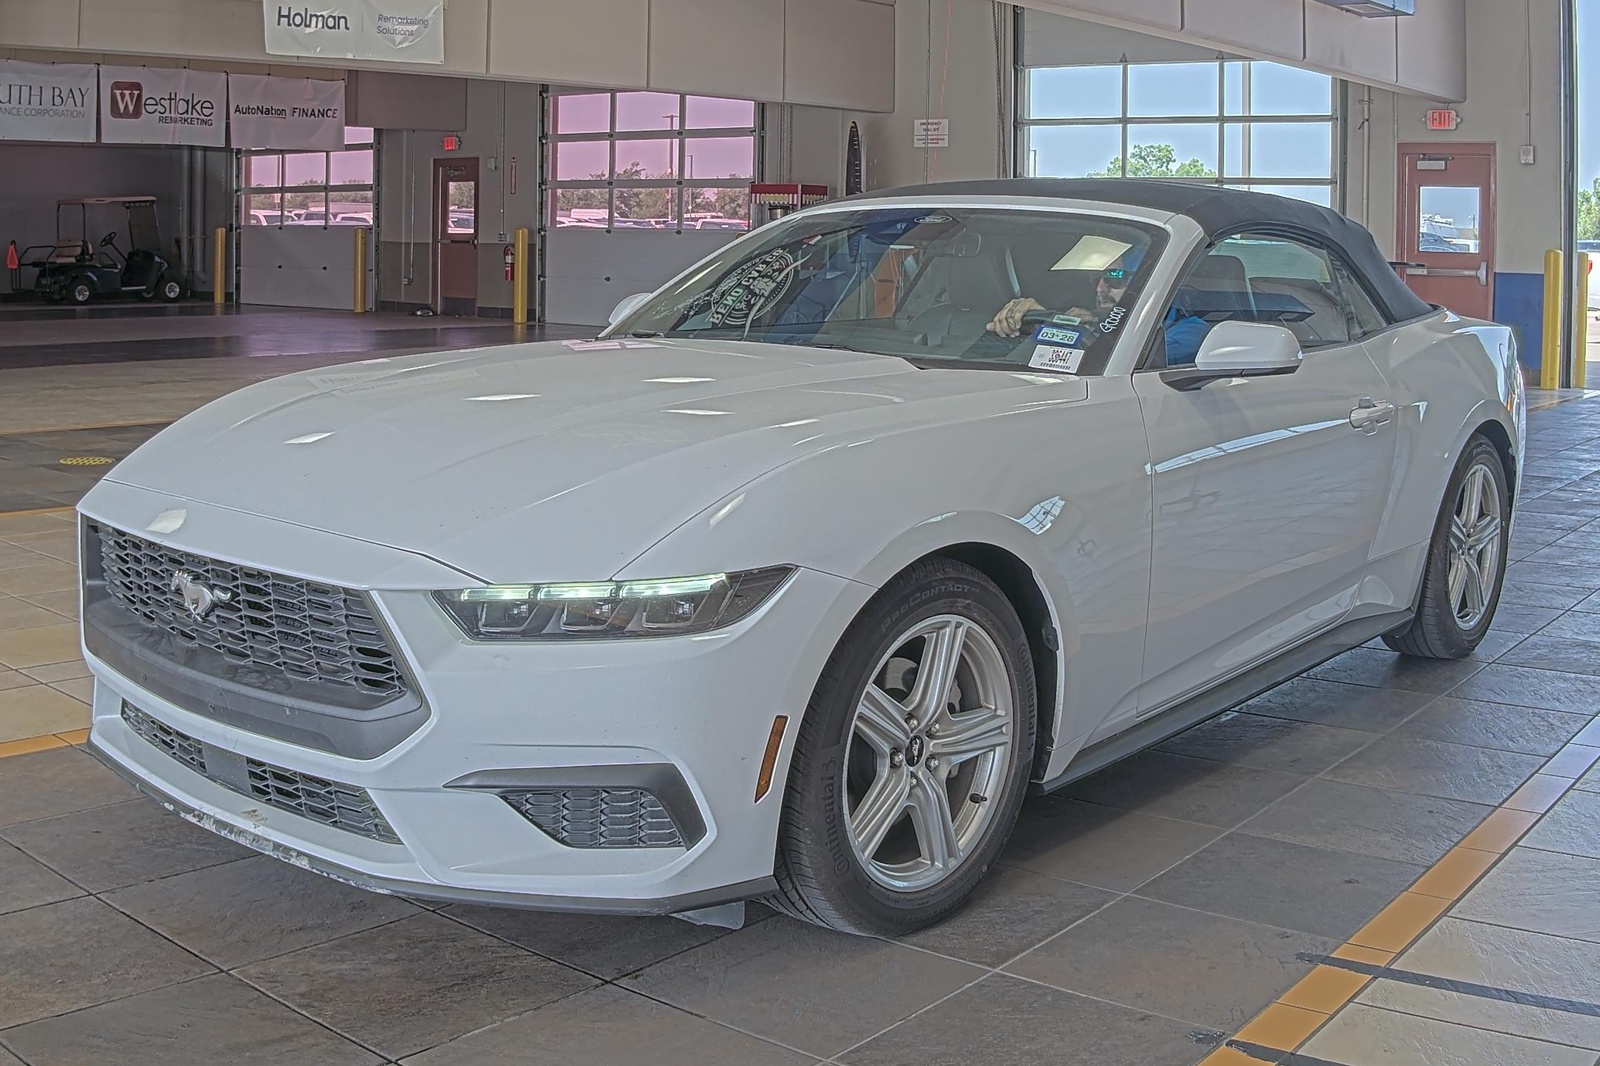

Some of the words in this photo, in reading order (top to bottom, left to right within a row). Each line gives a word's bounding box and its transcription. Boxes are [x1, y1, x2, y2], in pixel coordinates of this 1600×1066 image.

[277, 6, 350, 31] Holman
[378, 14, 429, 28] Remarketing
[376, 26, 414, 36] Solutions
[52, 86, 90, 108] BAY
[113, 89, 215, 117] Westlake
[24, 108, 86, 118] CORPORATION
[234, 104, 287, 117] AutoNation
[291, 107, 338, 118] FINANCE
[158, 115, 214, 127] REMARKETING
[1431, 111, 1452, 128] EXIT
[1040, 332, 1056, 340] 03
[1059, 334, 1075, 342] 28
[821, 775, 850, 877] Continental
